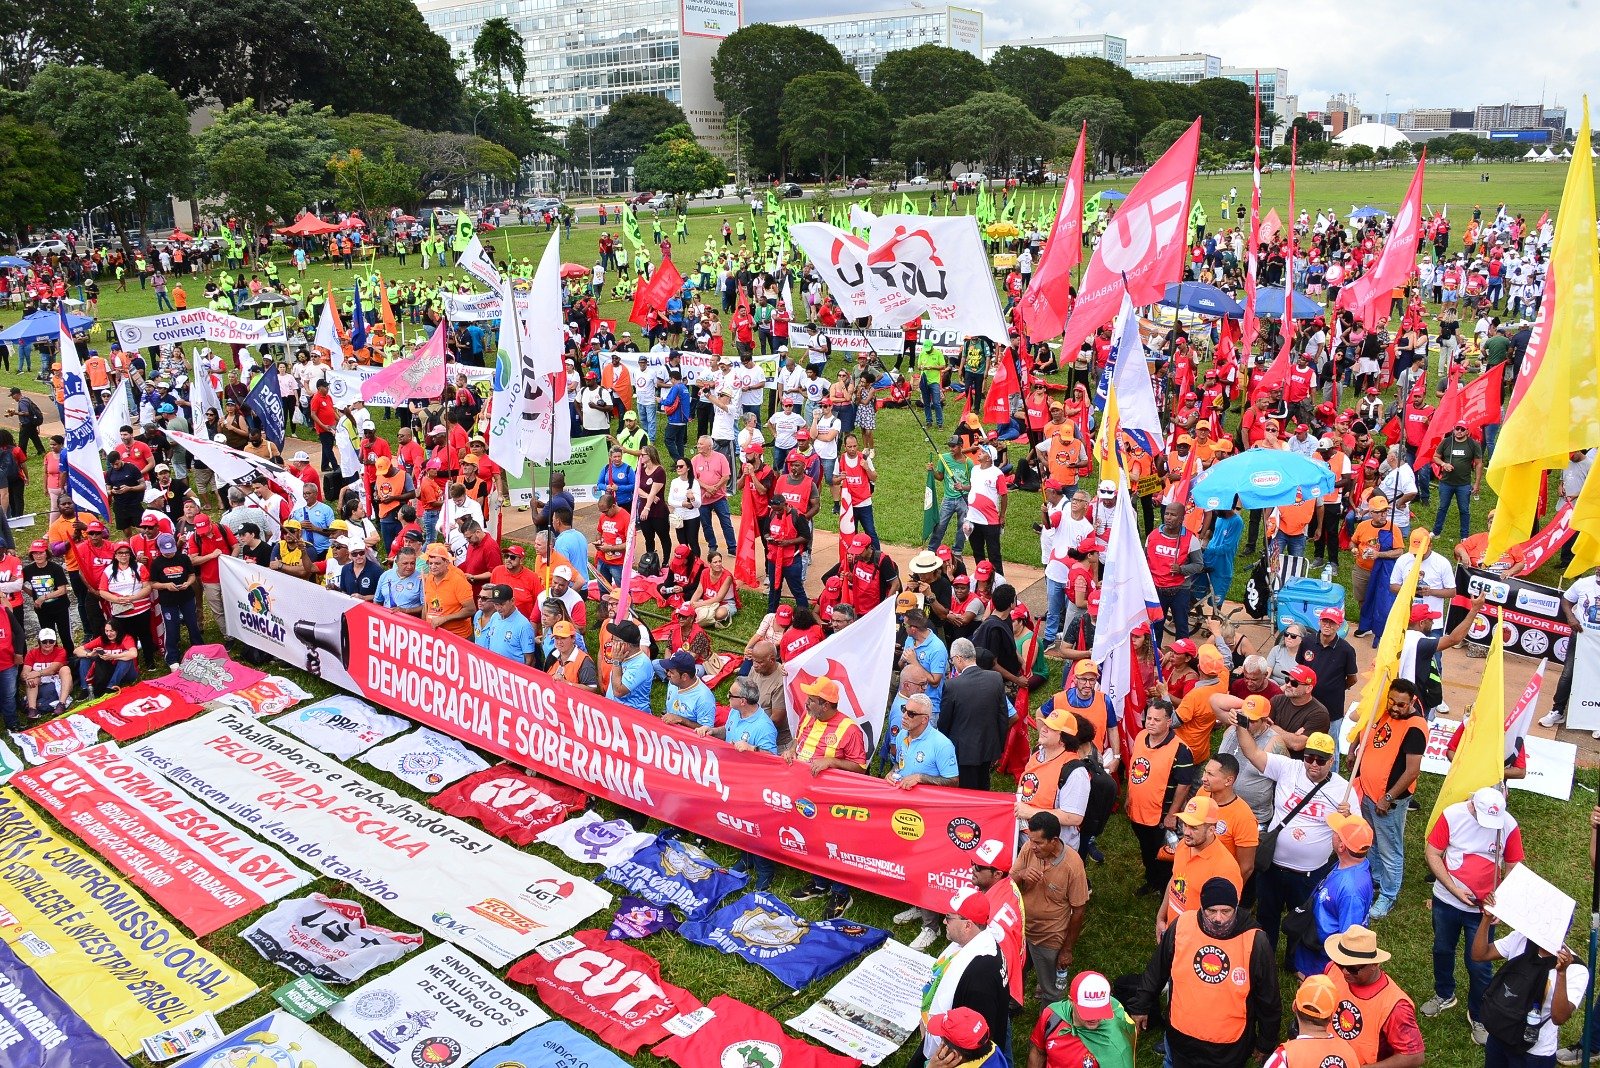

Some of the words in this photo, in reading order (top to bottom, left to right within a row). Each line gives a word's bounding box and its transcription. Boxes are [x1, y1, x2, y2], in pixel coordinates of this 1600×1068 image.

[155, 316, 179, 328] PELA
[239, 322, 253, 331] DA
[208, 327, 226, 338] 156
[228, 329, 242, 339] DA
[854, 568, 871, 583] CUT
[240, 611, 287, 643] CONCLAT
[786, 636, 810, 652] CUT
[368, 615, 464, 691] EMPREGO,
[469, 656, 566, 737] DIREITOS,
[567, 697, 629, 757] VIDA
[633, 726, 730, 802] DIGNA,
[368, 655, 493, 741] DEMOCRACIA
[497, 710, 512, 748] E
[515, 716, 654, 807] SOBERANIA
[40, 765, 96, 800] CUT
[216, 712, 323, 776] Trabalhadores
[326, 771, 343, 783] e
[341, 779, 494, 856] Trabalhadoras!
[204, 735, 263, 765] PELO
[251, 759, 305, 787] FIM
[297, 783, 340, 810] DA
[326, 804, 431, 859] ESCALA
[470, 777, 562, 818] CUT
[762, 788, 793, 809] CSB
[78, 745, 134, 779] PELO
[164, 807, 254, 867] ESCALA
[239, 854, 298, 889] 6X1
[134, 745, 174, 776] Vocês
[167, 765, 231, 805] Merecem
[296, 842, 323, 858] do
[319, 850, 400, 902] trabalho
[716, 811, 755, 834] CUT
[831, 804, 869, 822] CTB
[899, 815, 918, 823] NCST
[951, 818, 977, 829] FORÇA
[590, 822, 618, 842] CUT
[779, 836, 806, 850] UGT
[949, 832, 980, 850] SINDICAL
[840, 851, 906, 875] INTERSINDICAL
[175, 859, 197, 875] DE
[188, 866, 247, 909] TRABALHO!
[525, 883, 564, 905] UGT
[42, 846, 172, 952] COMPROMISSO
[0, 861, 76, 920] FORTALECER
[63, 921, 133, 974] INVESTIR
[126, 978, 195, 1025] BRASIL!
[1197, 945, 1227, 963] FORÇA
[553, 949, 667, 1017] CUT
[1193, 962, 1231, 984] SINDICAL
[425, 963, 512, 1028] METALÚRGICOS
[442, 955, 503, 1002] SINDICATO
[501, 996, 529, 1019] DOS
[1084, 990, 1107, 1000] LULA
[417, 979, 436, 995] DE
[431, 990, 484, 1030] SUZANO
[11, 1000, 69, 1050] CORREIOS
[1332, 1013, 1361, 1040] SINDICAL
[271, 1051, 287, 1062] 12
[436, 1037, 461, 1057] FORÇA
